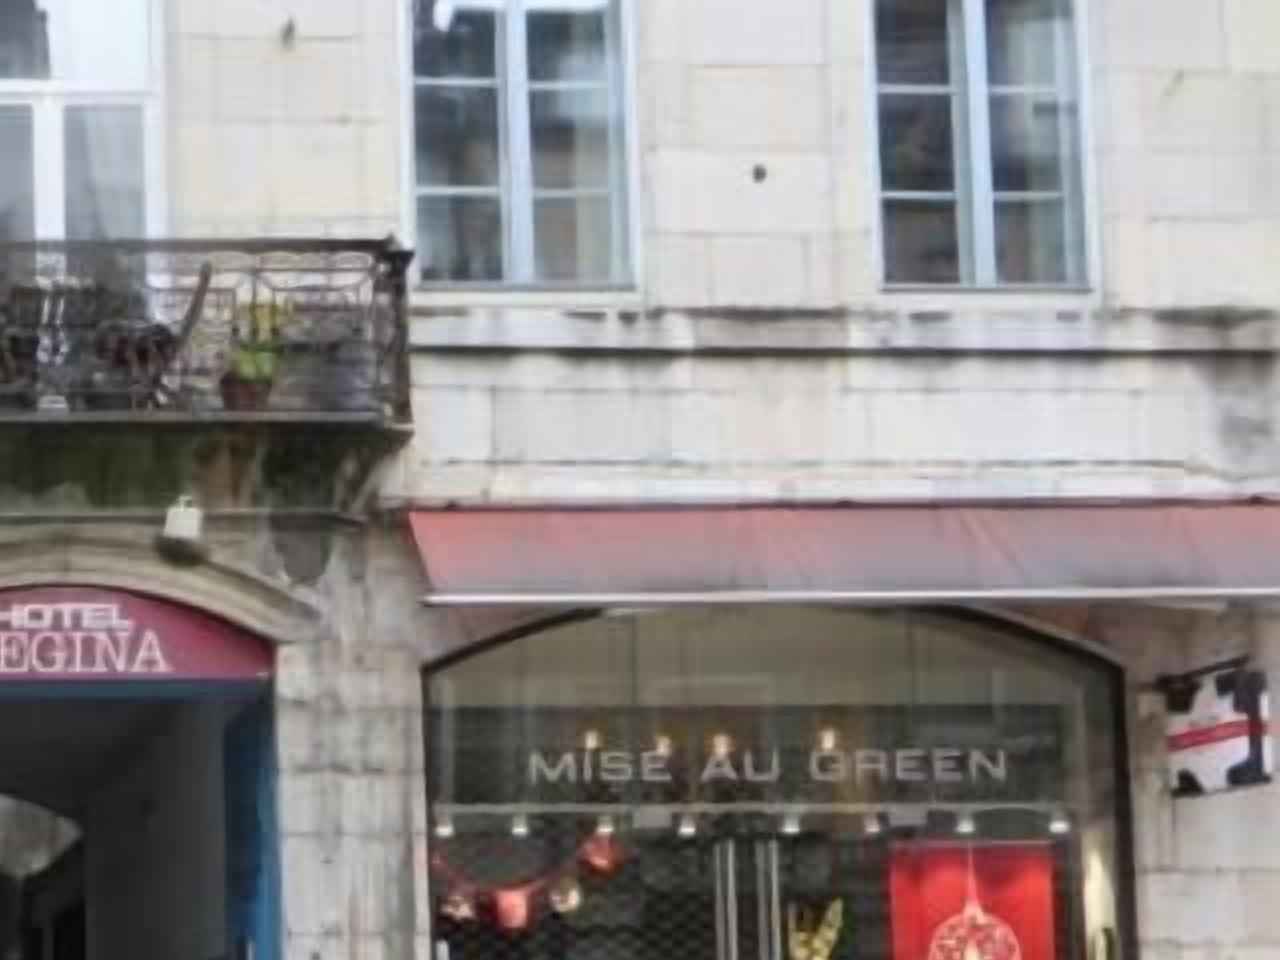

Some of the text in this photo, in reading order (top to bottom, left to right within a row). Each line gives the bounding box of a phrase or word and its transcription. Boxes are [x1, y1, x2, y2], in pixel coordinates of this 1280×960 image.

[528, 747, 1007, 785] MISE AU GREEN
